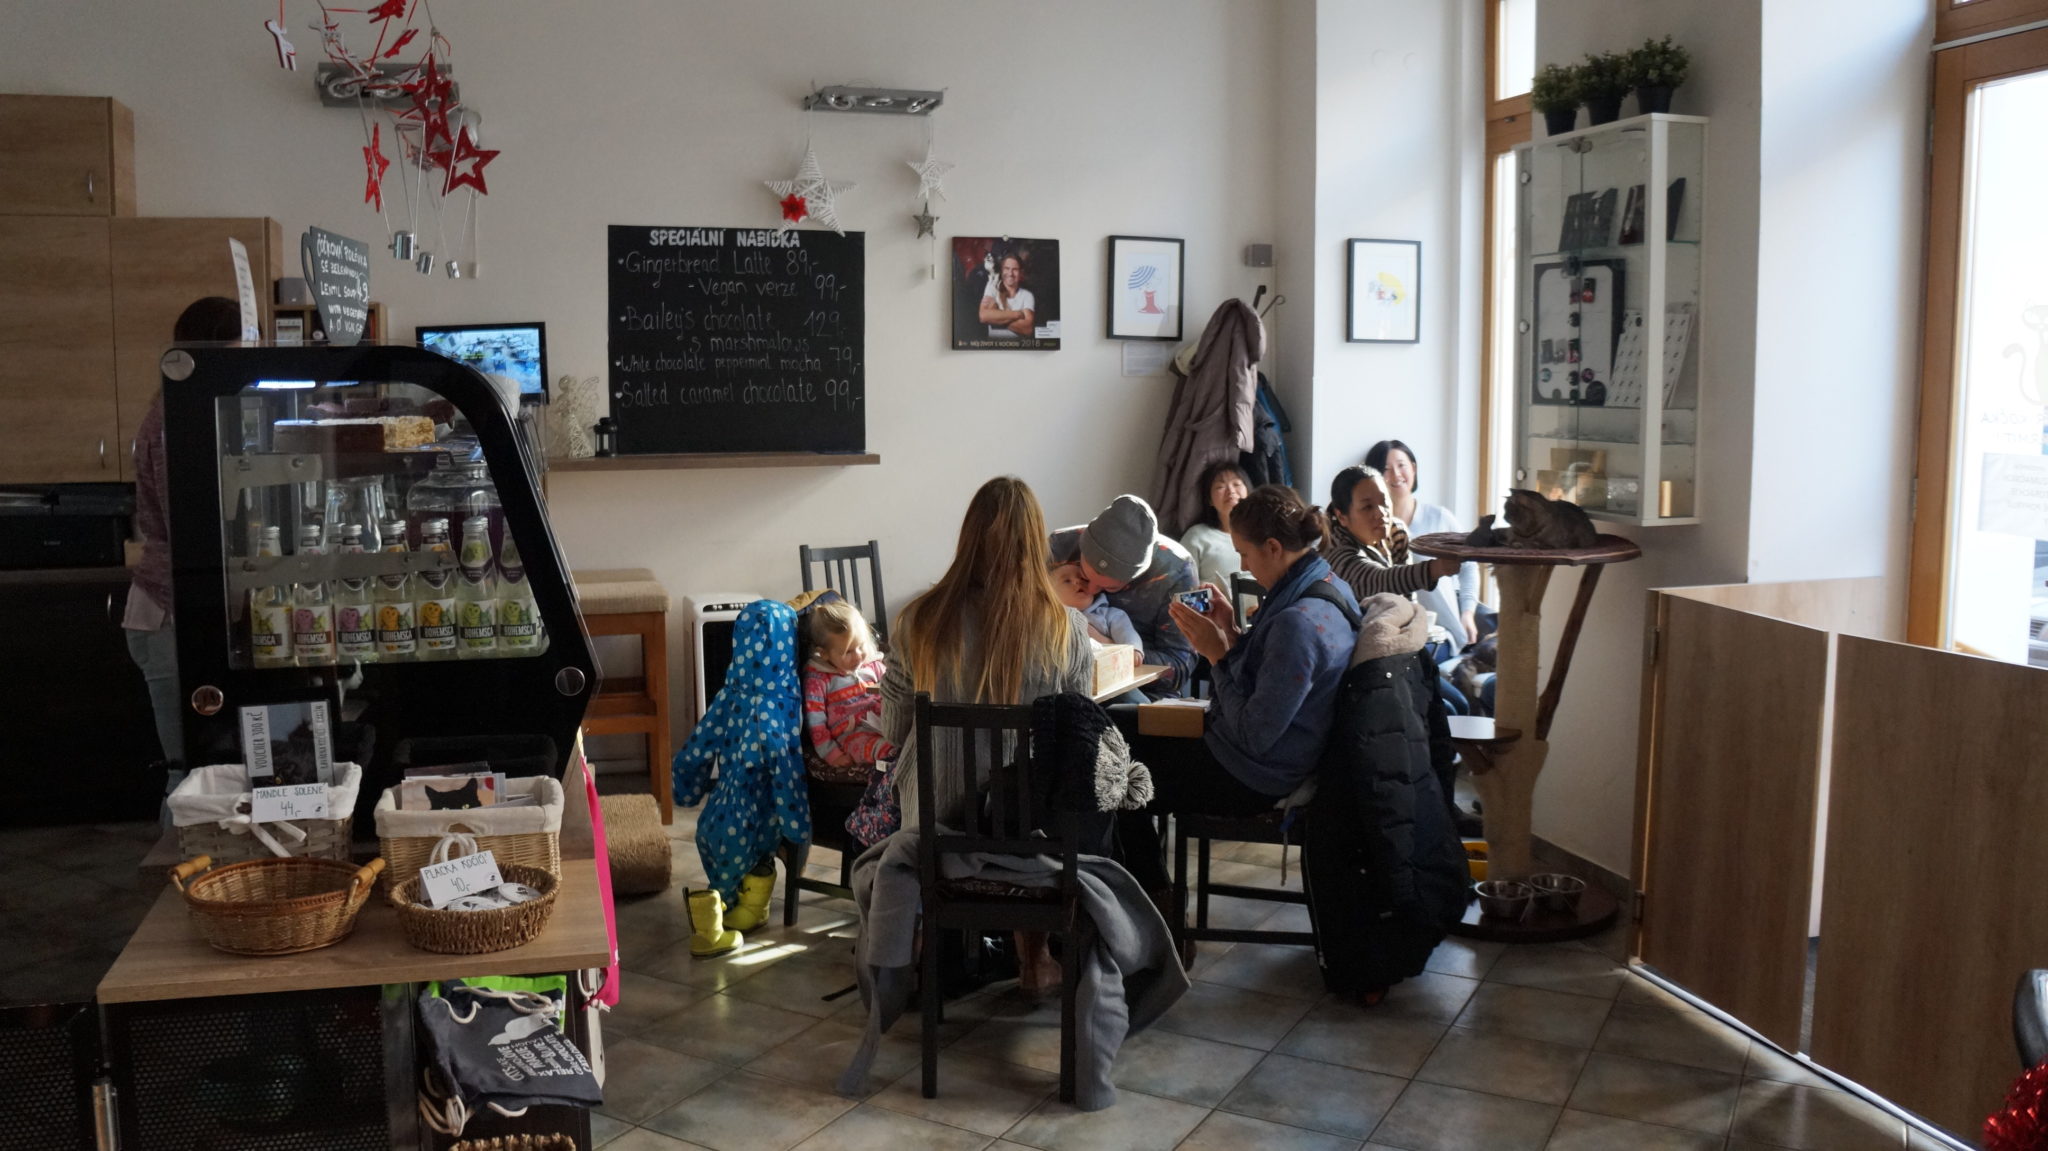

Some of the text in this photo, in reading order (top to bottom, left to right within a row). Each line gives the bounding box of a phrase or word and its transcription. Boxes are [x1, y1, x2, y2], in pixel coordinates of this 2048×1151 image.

[650, 228, 800, 248] SPECIÁLNÍ NABÍDKA
[733, 250, 772, 274] Latte
[321, 281, 341, 297] LENTIL
[699, 278, 747, 305] Vegan
[756, 280, 799, 297] verze
[704, 304, 778, 331] chocolate
[656, 351, 707, 371] chocolate
[744, 378, 817, 403] chocolate
[256, 788, 289, 799] MANDLE
[424, 864, 458, 879] PLACKA
